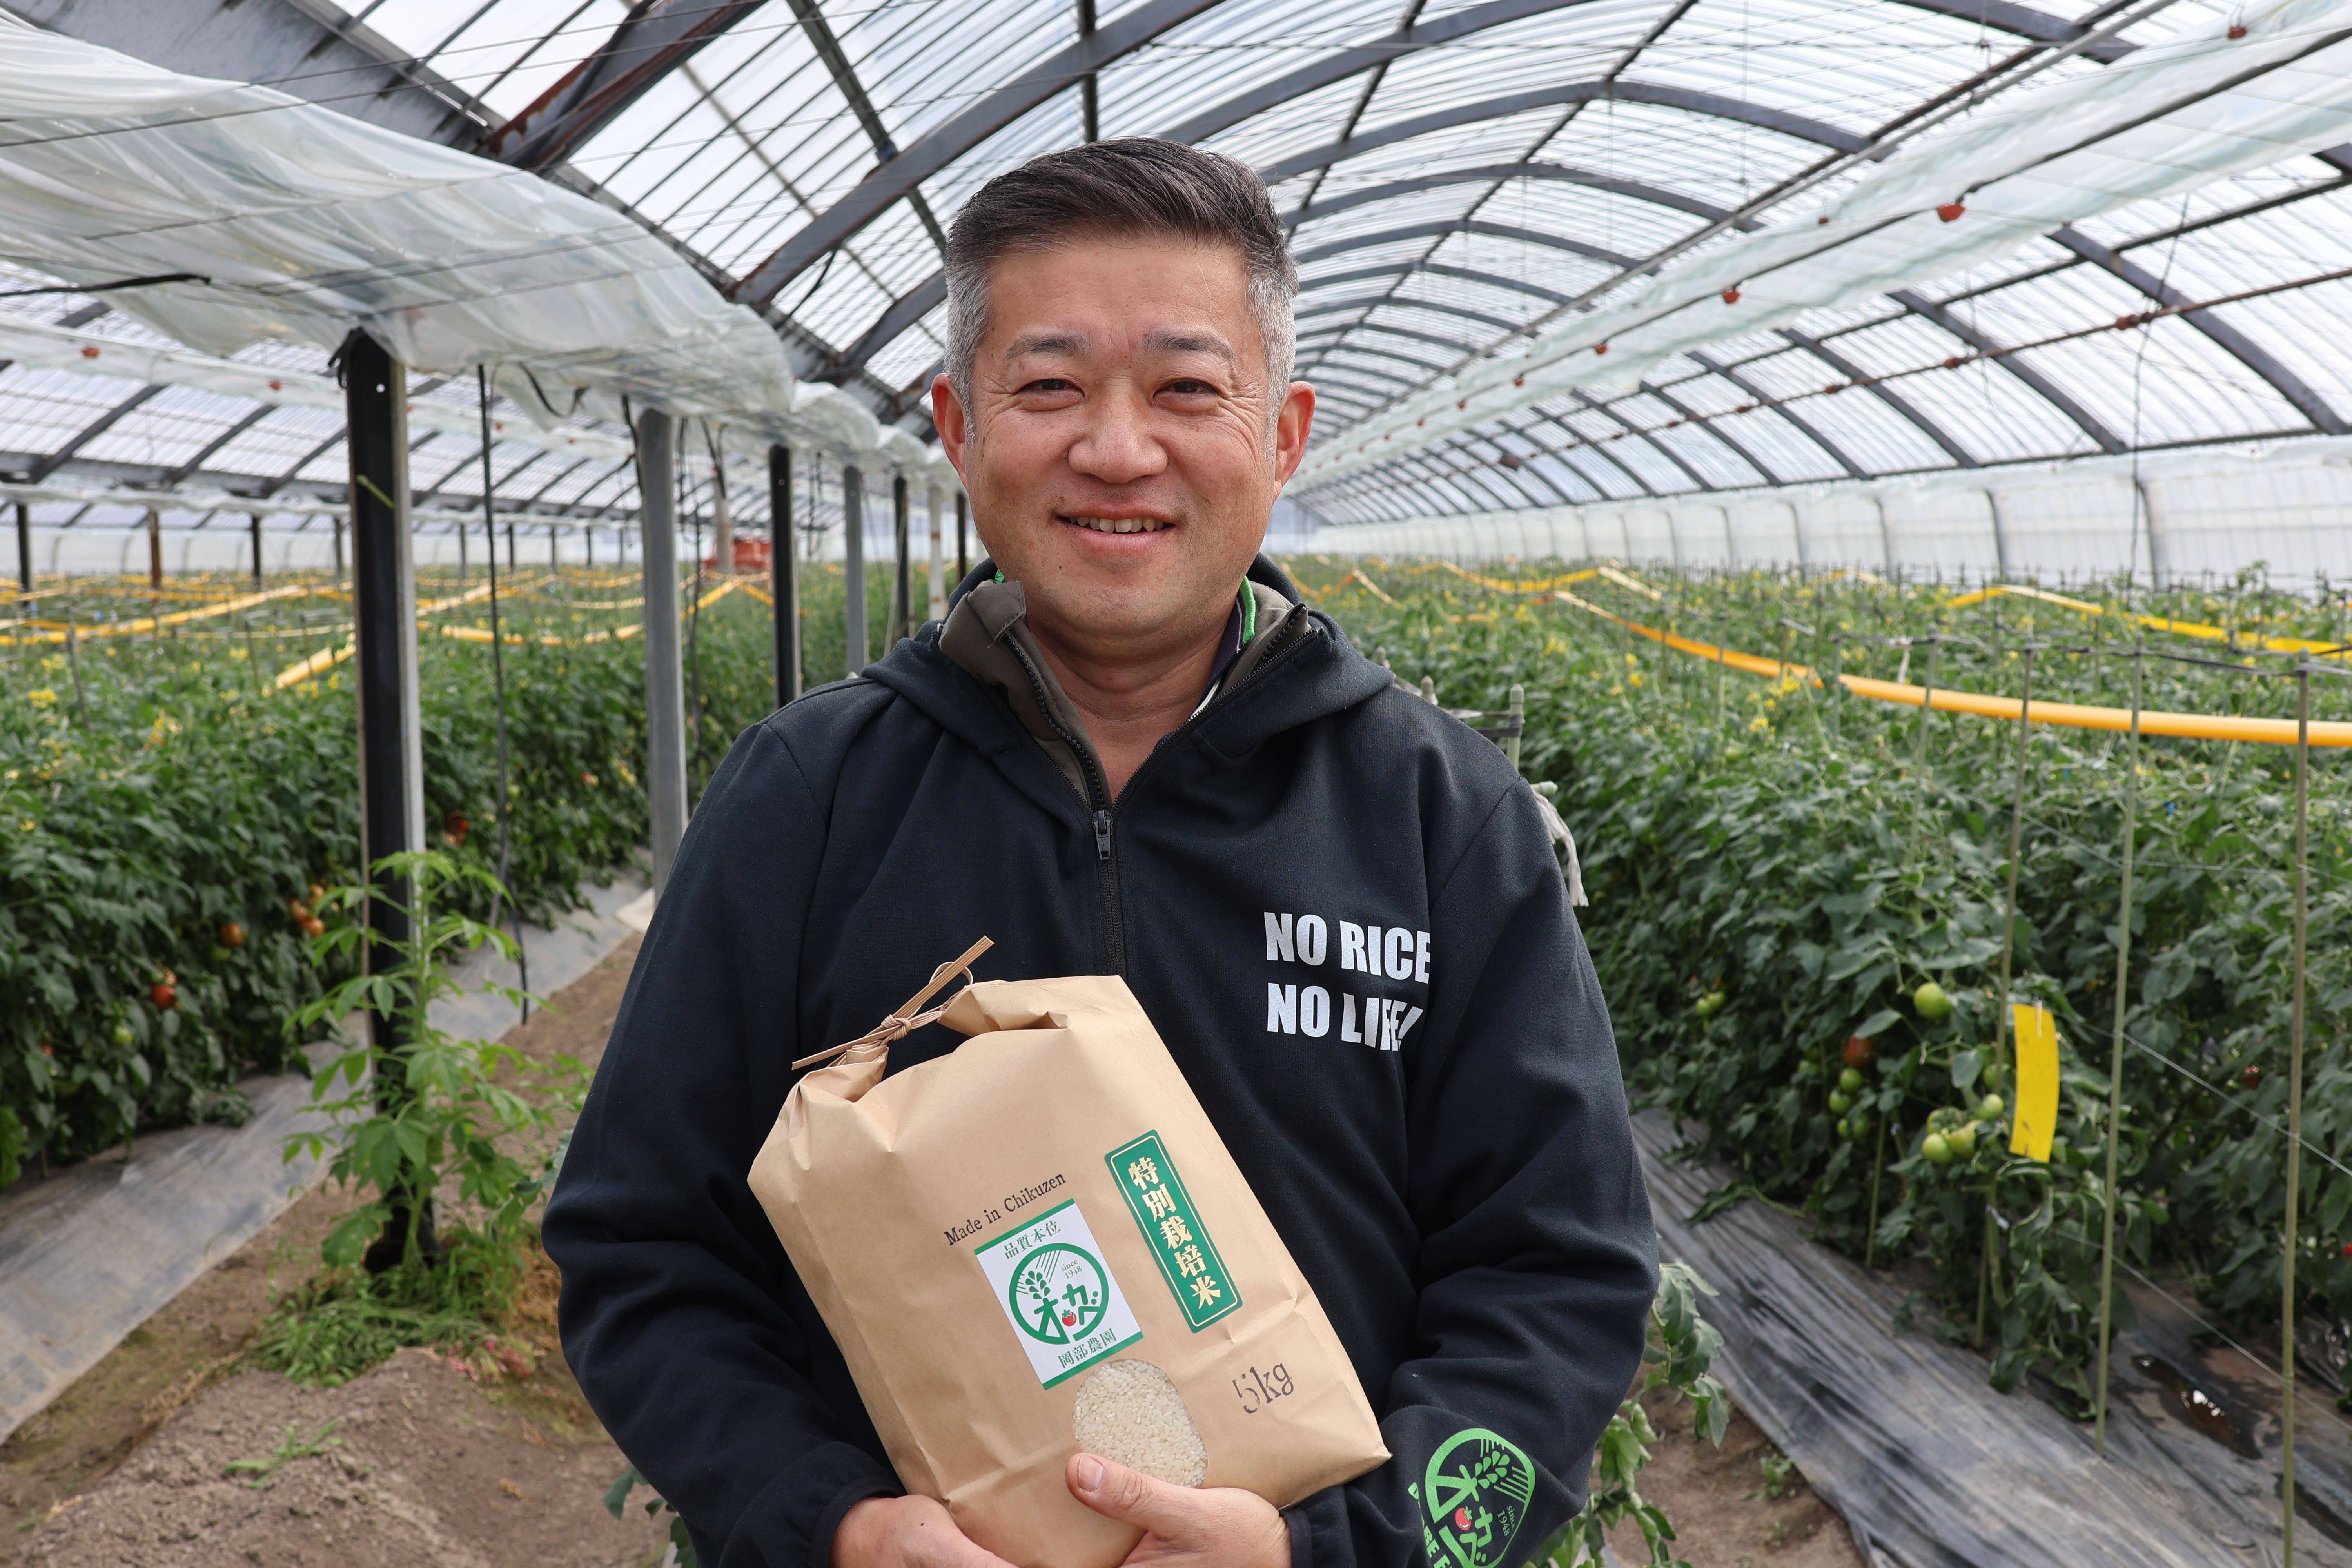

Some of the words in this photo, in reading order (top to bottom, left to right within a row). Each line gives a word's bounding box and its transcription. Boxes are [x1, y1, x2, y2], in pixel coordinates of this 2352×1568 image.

[1264, 912, 1327, 966] NO
[1339, 920, 1430, 984] RICE
[1267, 982, 1330, 1038] NO
[944, 1218, 983, 1246] Made
[984, 1209, 1002, 1224] in
[1004, 1174, 1066, 1212] Chikuzen
[1004, 1220, 1062, 1259] 品質本位
[1128, 1157, 1221, 1310] 特別栽培米
[1061, 1260, 1078, 1272] since
[1065, 1266, 1082, 1279] 1948
[1058, 1328, 1117, 1369] 岡部農園
[1232, 1362, 1294, 1414] 5kg
[1497, 1510, 1510, 1536] 1948
[1507, 1505, 1515, 1530] since
